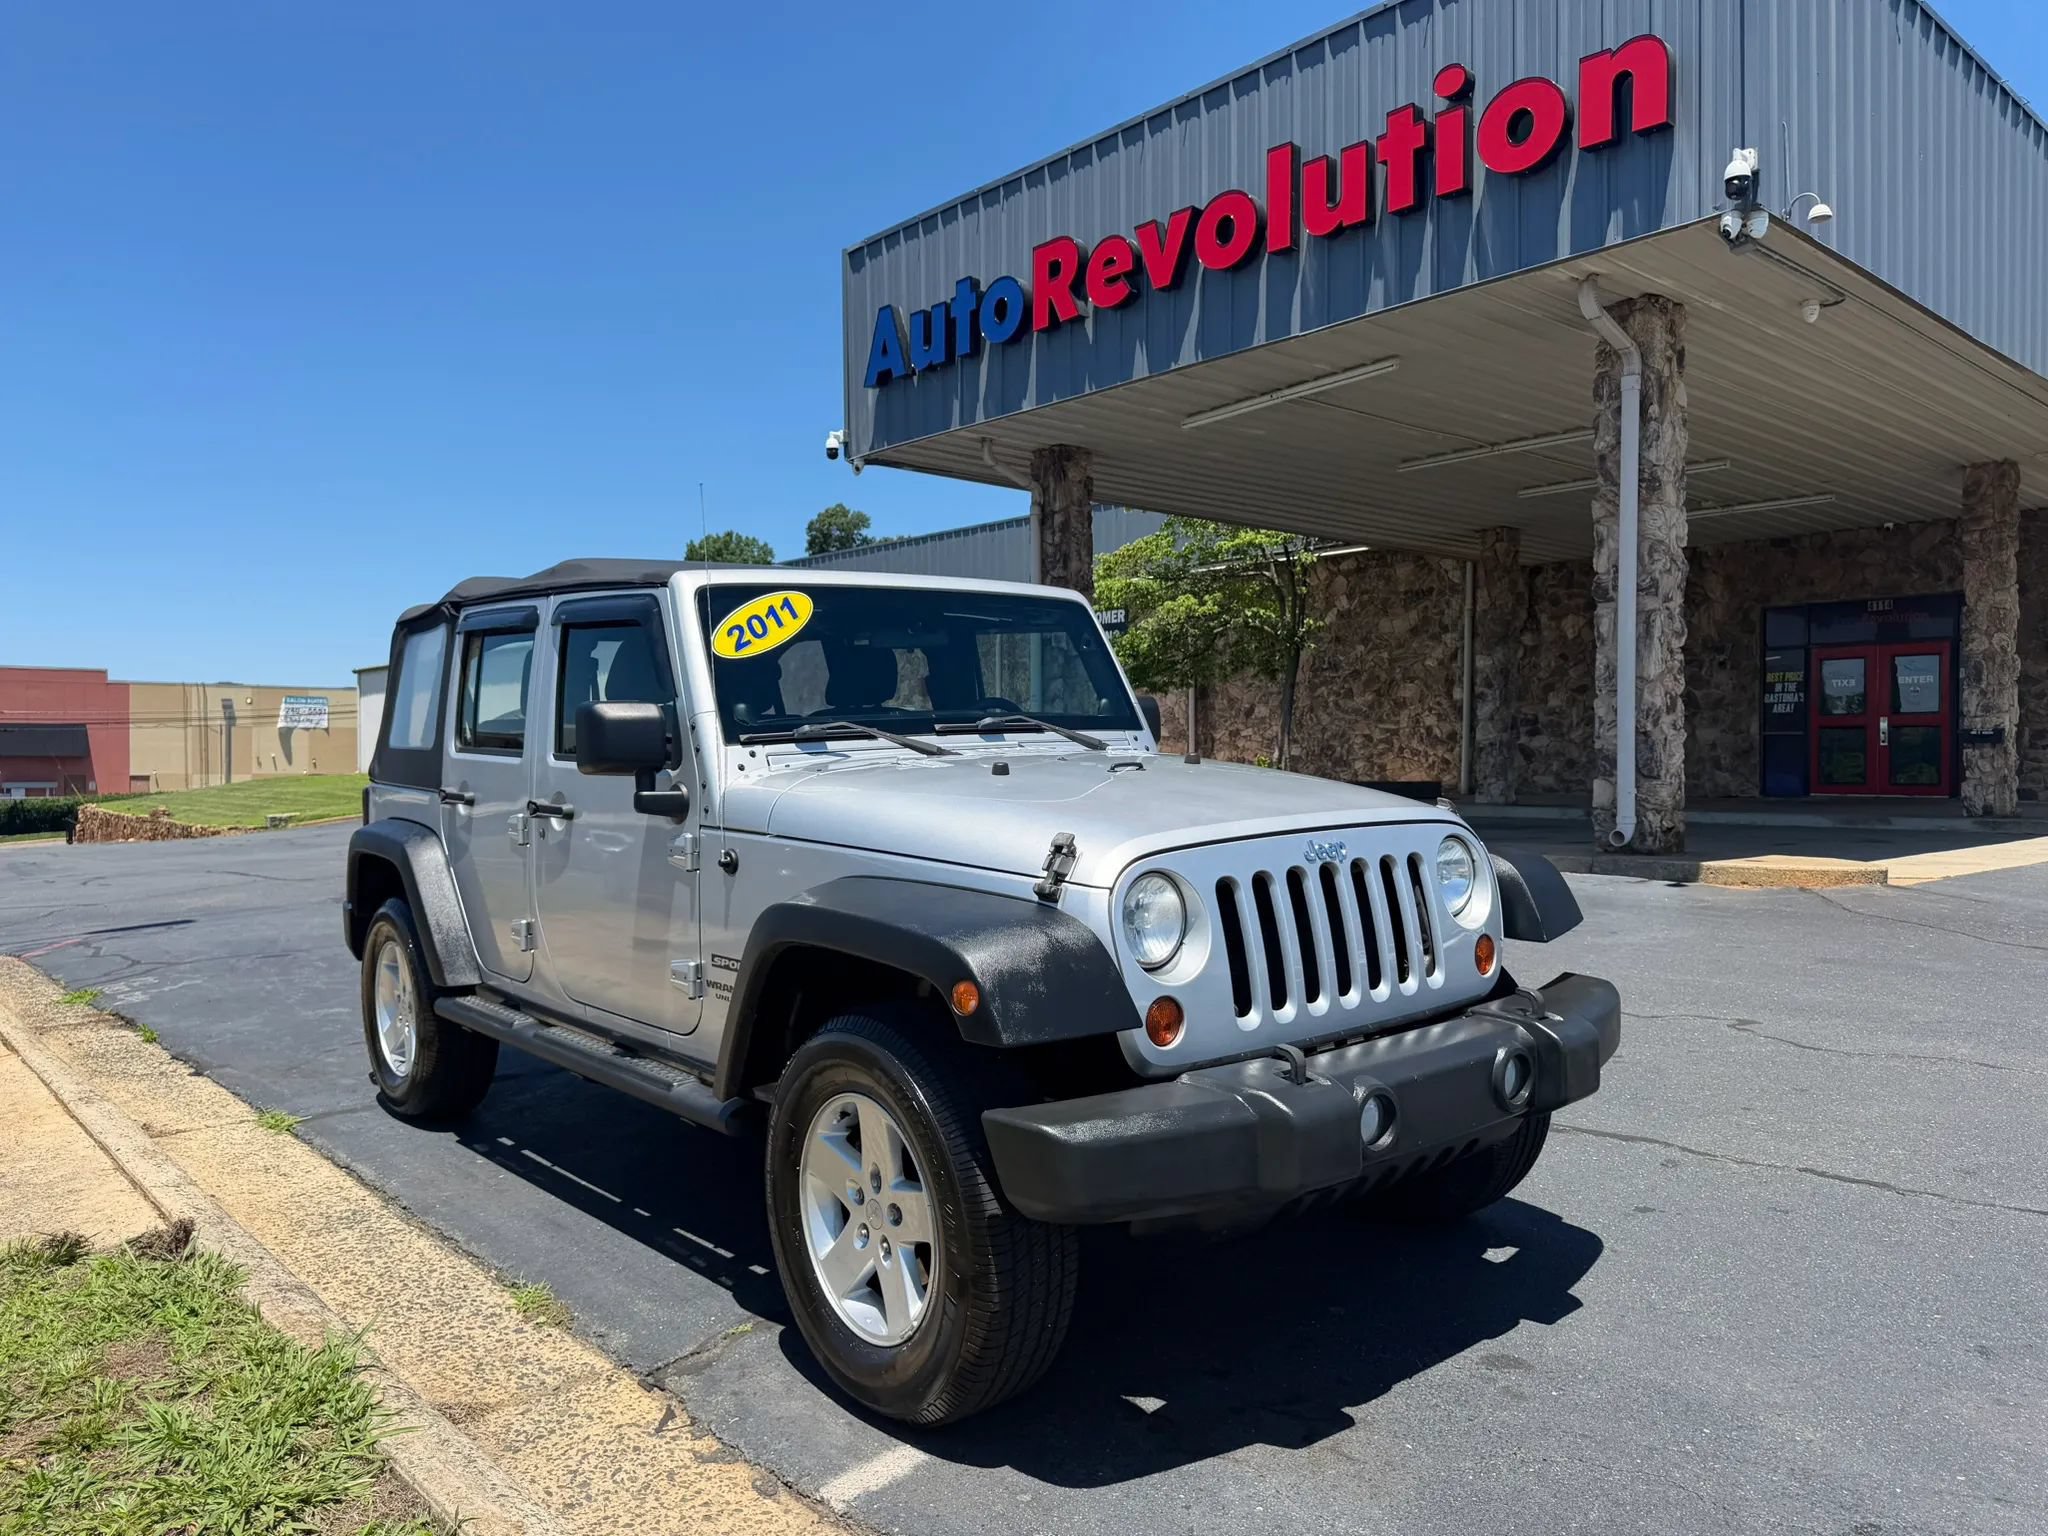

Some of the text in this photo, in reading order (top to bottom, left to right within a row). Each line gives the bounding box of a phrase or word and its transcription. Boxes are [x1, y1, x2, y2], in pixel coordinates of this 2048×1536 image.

[726, 596, 799, 653] 2011
[1898, 675, 1933, 684] ENTER
[1303, 839, 1347, 864] Jeep
